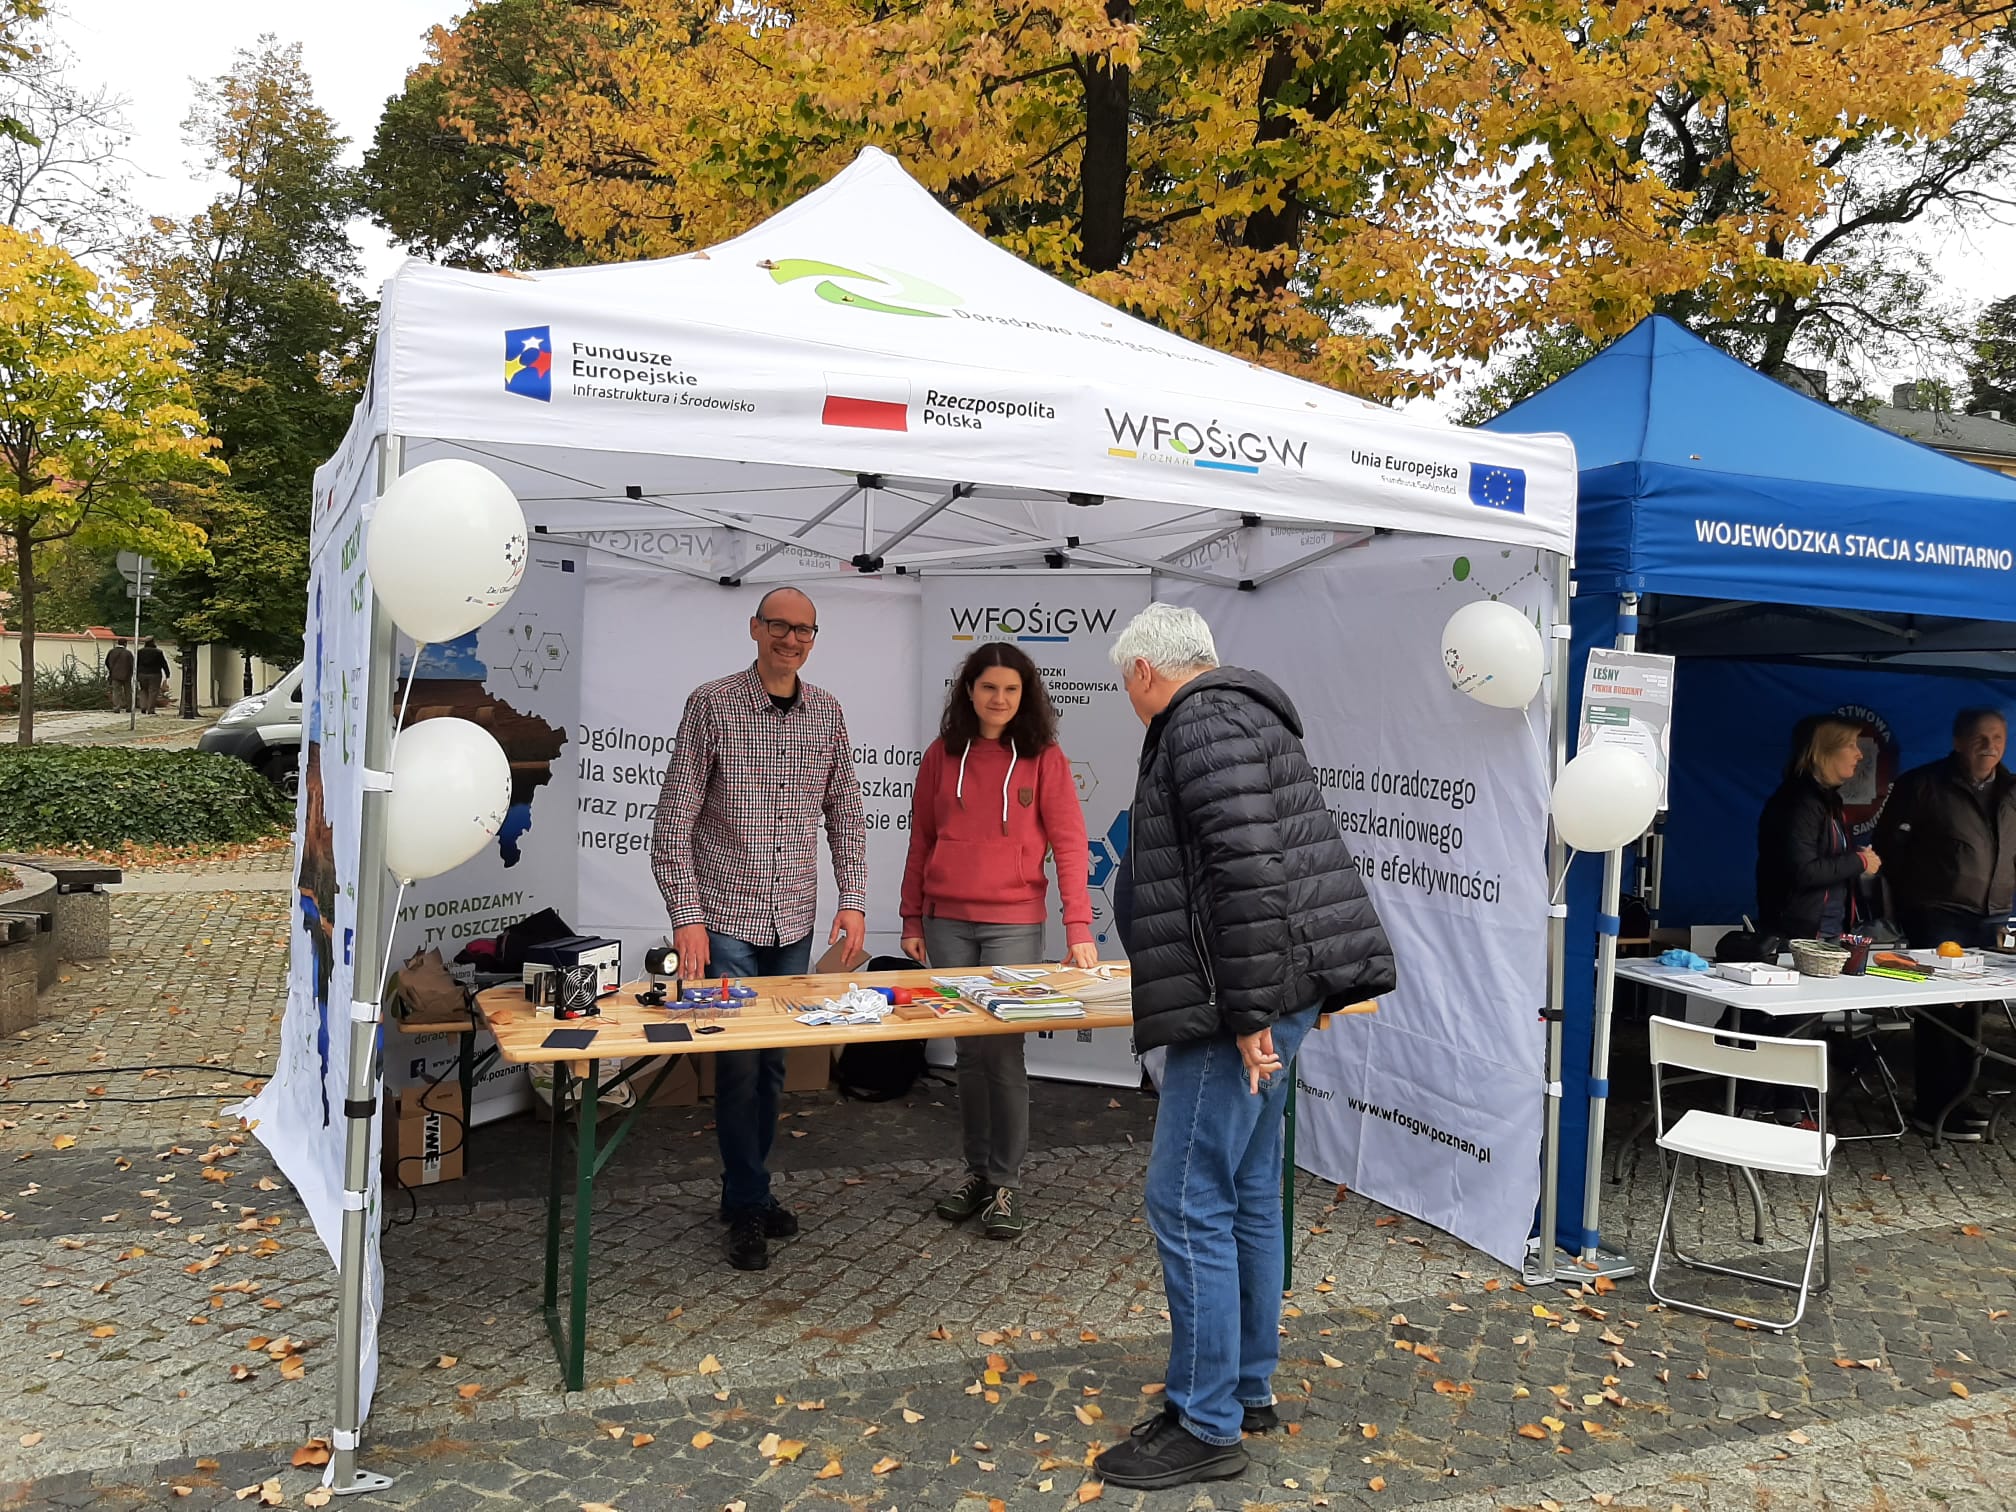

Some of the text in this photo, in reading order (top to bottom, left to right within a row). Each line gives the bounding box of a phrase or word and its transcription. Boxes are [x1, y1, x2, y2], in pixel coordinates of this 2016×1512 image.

[951, 308, 1073, 336] Doradztwo
[572, 342, 673, 366] Fundusze
[572, 359, 698, 386] Europejskie
[572, 384, 756, 413] Infrastruktura i Środowisko
[926, 389, 1055, 419] Rzeczpospolita
[923, 409, 982, 429] Polska
[1104, 407, 1308, 469] WFOŚiGW
[1351, 450, 1459, 479] Unia Europejska
[1695, 519, 2013, 571] WOJEWÓDZKA STACJA SANITARNO
[950, 602, 1117, 634] WFOŚiGW
[1048, 680, 1119, 692] ŚRODOWISKA
[578, 724, 677, 757] Ogólnopo
[852, 743, 922, 767] cia dora
[612, 763, 667, 786] sekto
[1312, 763, 1477, 810] sparcia doradczego
[624, 801, 659, 822] prz
[865, 808, 890, 830] sie
[1353, 849, 1502, 904] sie efektywności
[424, 890, 524, 919] DORADZAMY
[425, 926, 446, 944] TY
[1347, 1096, 1492, 1164] www.wfosgw.poznan.pl
